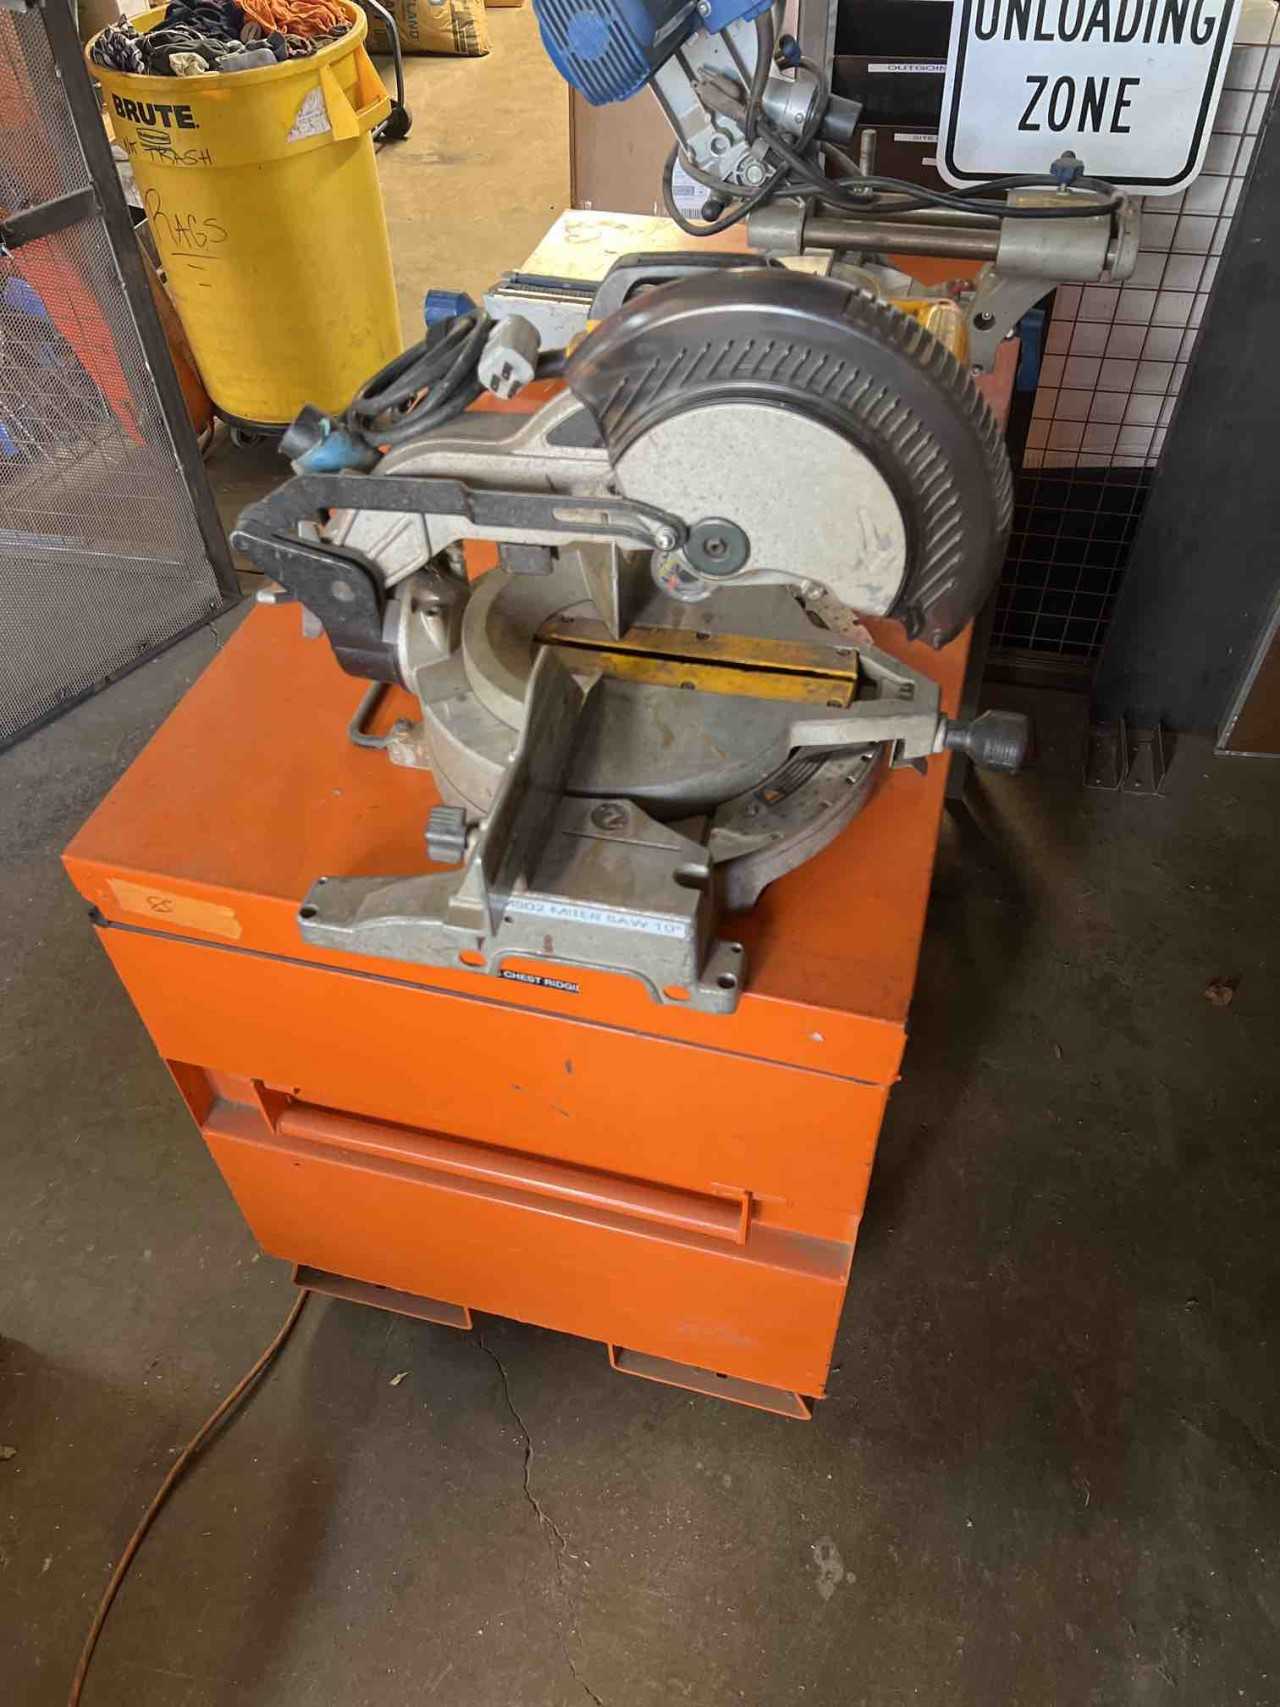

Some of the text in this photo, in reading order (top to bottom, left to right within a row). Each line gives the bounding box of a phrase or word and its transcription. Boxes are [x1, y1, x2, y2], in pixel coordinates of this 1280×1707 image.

[974, 0, 1217, 45] UNLOADING
[887, 64, 946, 72] OUTGOIN
[1018, 75, 1141, 133] ZONE
[144, 188, 229, 249] RAGS
[544, 978, 579, 992] RIDGI
